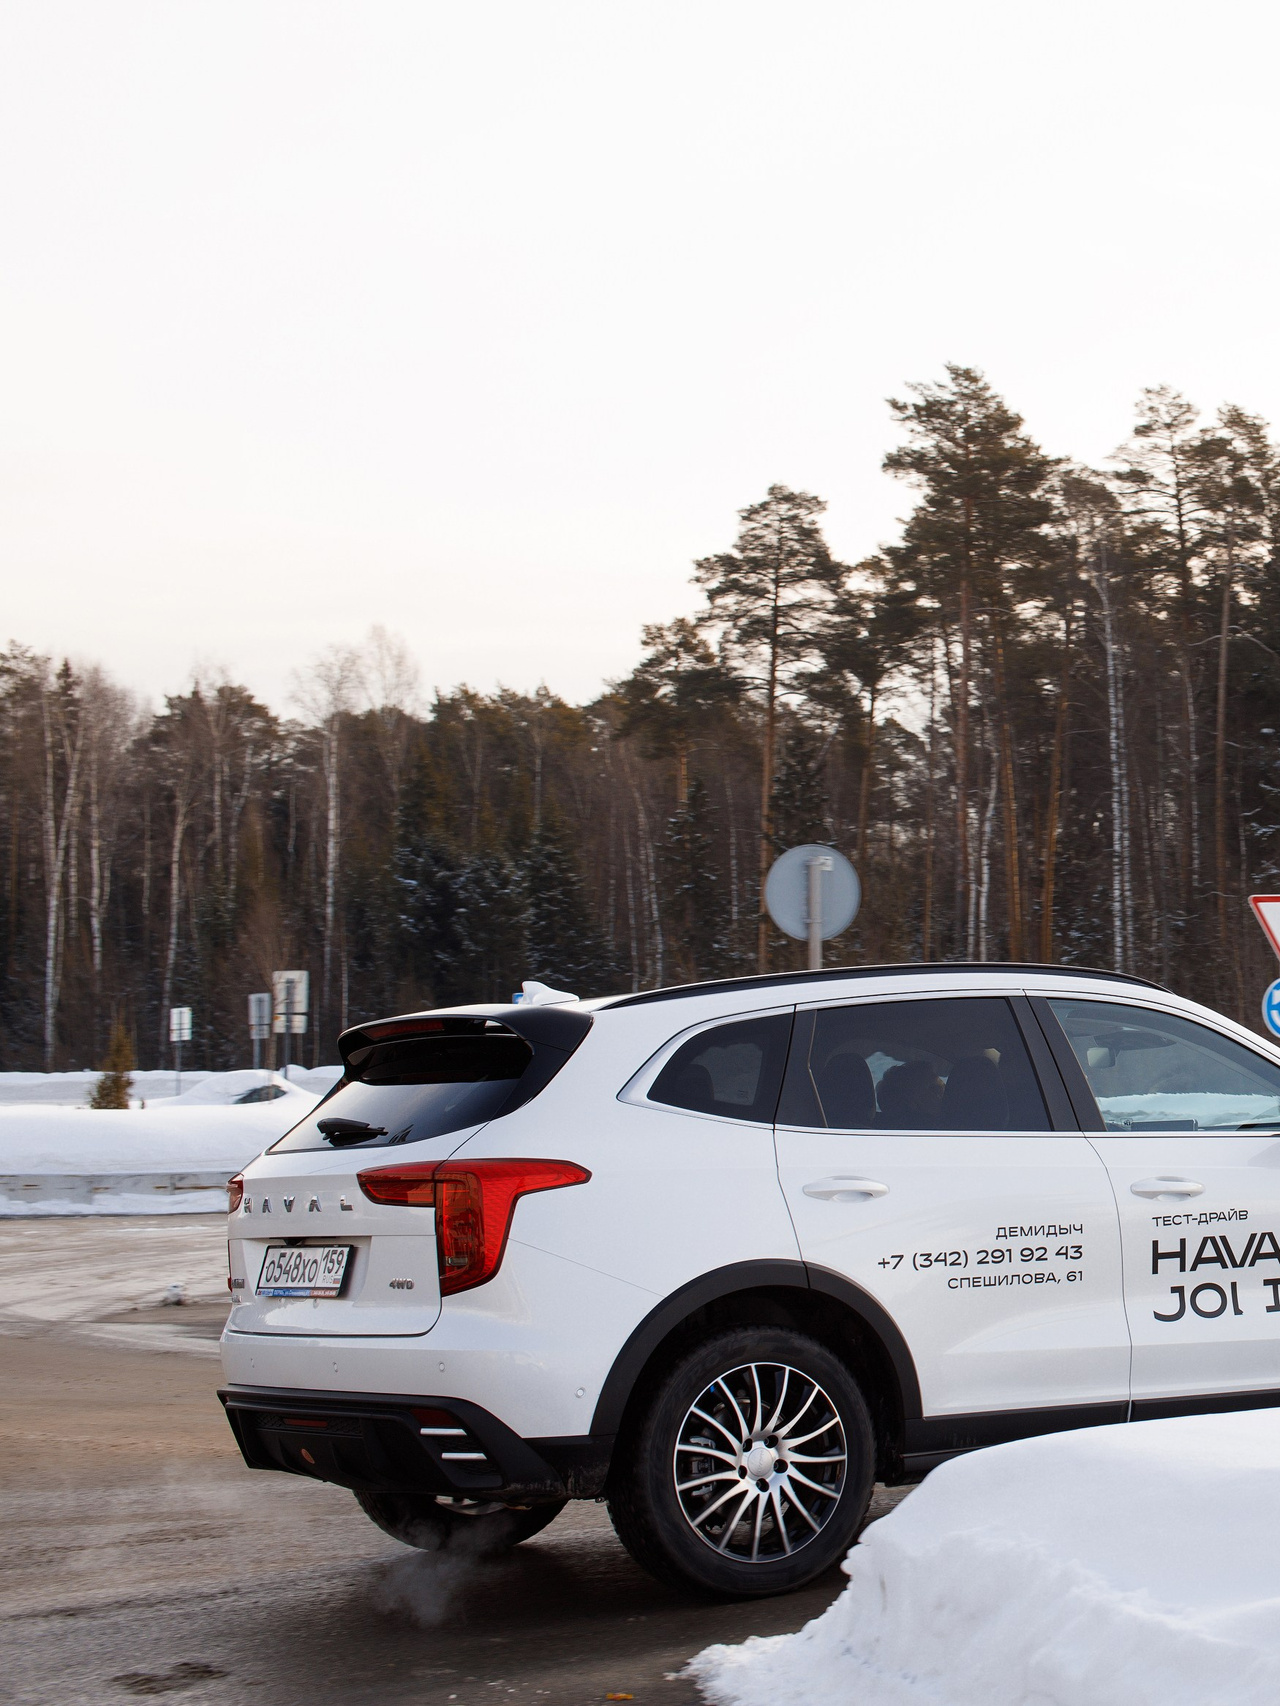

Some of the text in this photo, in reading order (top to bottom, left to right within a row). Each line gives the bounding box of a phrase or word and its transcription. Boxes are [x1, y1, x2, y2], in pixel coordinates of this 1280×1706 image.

[243, 1195, 353, 1213] HAVAL
[1151, 1208, 1249, 1227] ТЕСТ-ДРАЙВ
[995, 1223, 1083, 1241] ДЕМИДЫЧ
[322, 1249, 345, 1275] 159
[877, 1244, 1083, 1272] +7 (342) 291 92 43
[389, 1277, 415, 1290] 4WD
[947, 1270, 1083, 1290] СПЕШИЛОВА, 61
